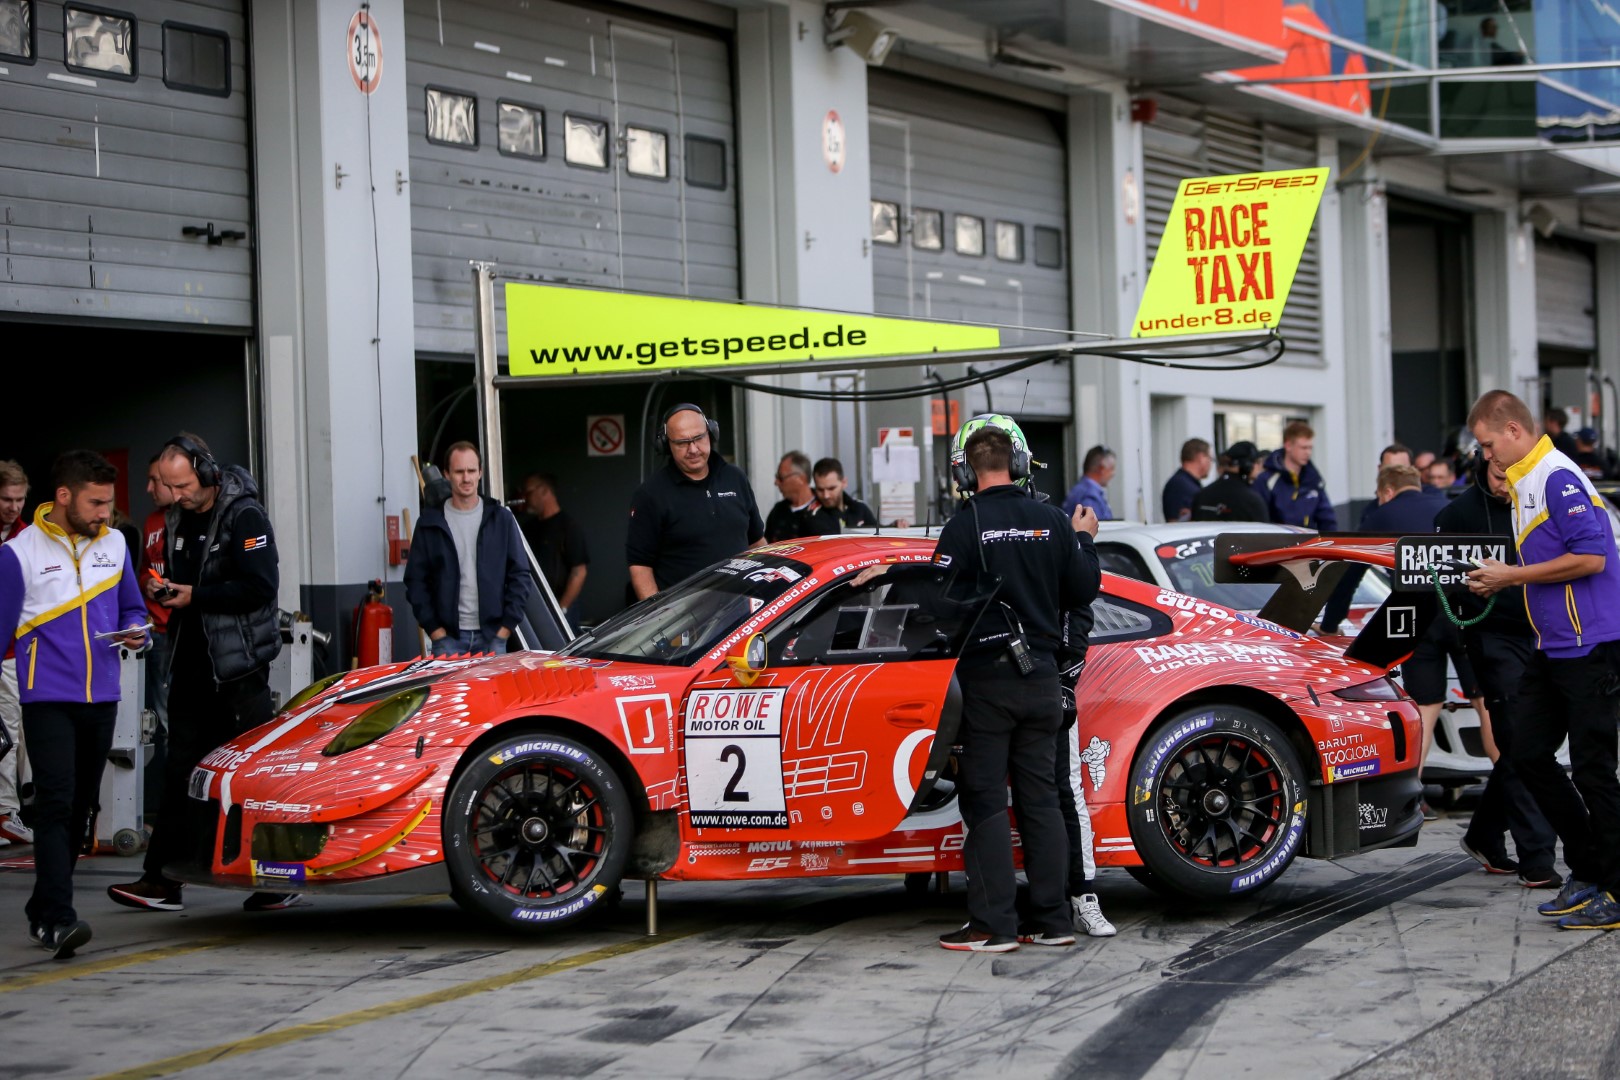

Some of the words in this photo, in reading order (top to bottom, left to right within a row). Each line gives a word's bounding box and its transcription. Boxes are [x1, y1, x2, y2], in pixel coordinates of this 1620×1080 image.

[1185, 202, 1271, 251] RACE
[1187, 251, 1274, 305] TAXI
[1140, 308, 1272, 330] under8.de
[530, 325, 867, 365] www.getspeed.de
[1401, 544, 1454, 571] RACE
[709, 577, 819, 661] www.getspeed.de
[1243, 615, 1294, 637] BASTUCK
[1134, 642, 1217, 664] RACE
[1213, 641, 1288, 657] TAXI
[1149, 654, 1295, 674] under8.de
[692, 694, 774, 719] ROWE
[690, 720, 739, 731] MOTOR
[743, 720, 766, 731] OIL
[515, 742, 583, 759] MICHELIN
[1146, 716, 1208, 774] MICHELIN
[1318, 734, 1363, 750] BARUTTI
[720, 744, 749, 802] 2
[1343, 764, 1375, 776] MICHELIN
[691, 813, 788, 826] www.rowe.com.de
[747, 840, 792, 852] MOTUL
[1238, 829, 1299, 888] MICHELIN
[264, 866, 298, 875] MICHELIN
[517, 901, 585, 920] MICHELIN
